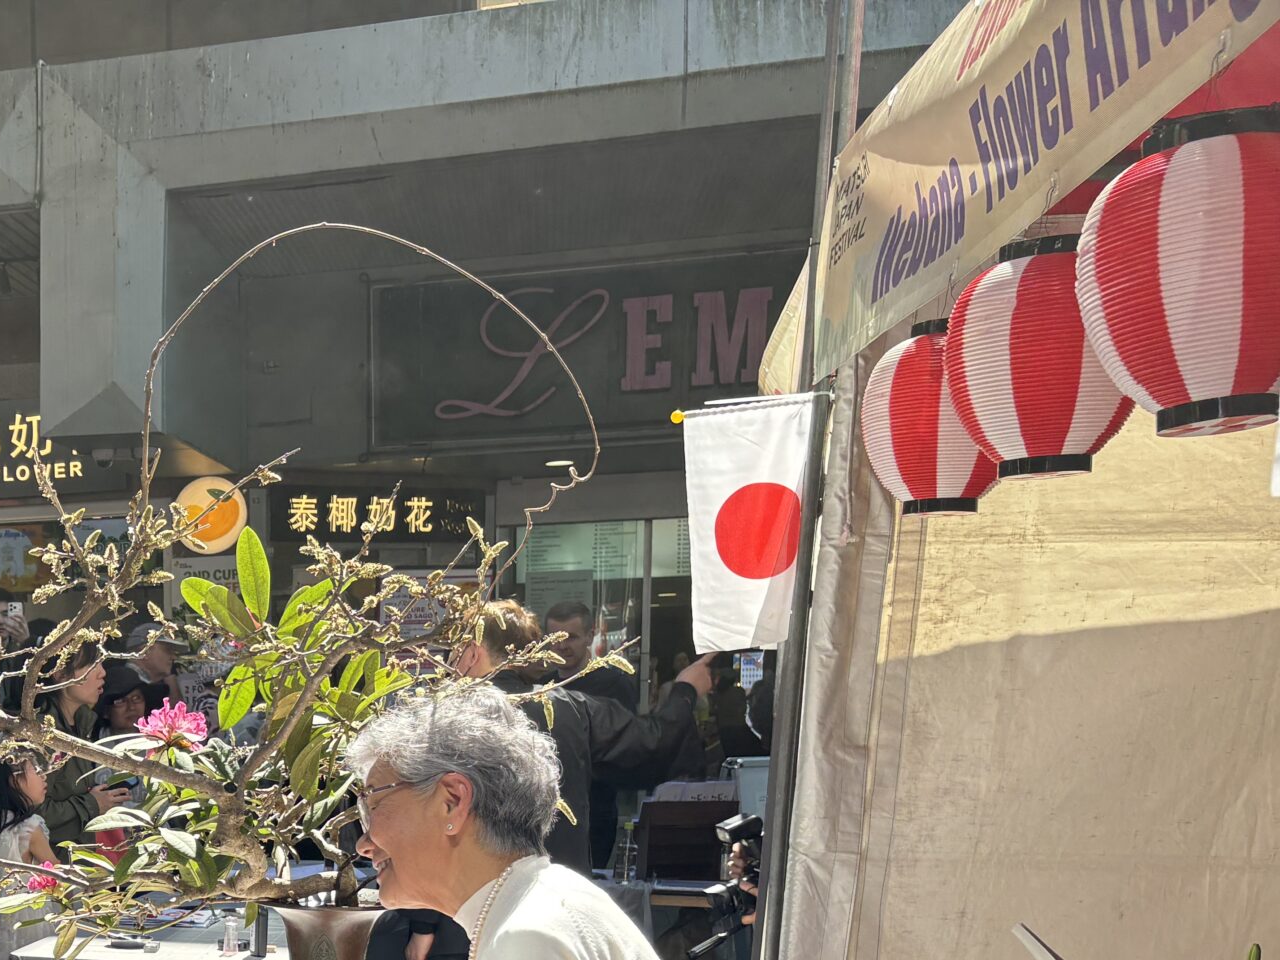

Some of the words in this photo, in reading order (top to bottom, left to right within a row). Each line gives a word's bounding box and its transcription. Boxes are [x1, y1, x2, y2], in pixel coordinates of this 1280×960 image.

[871, 157, 966, 305] Ikebana
[969, 18, 1073, 214] Flower
[829, 216, 867, 270] FESTIVAL
[288, 494, 434, 533] 泰椰奶花
